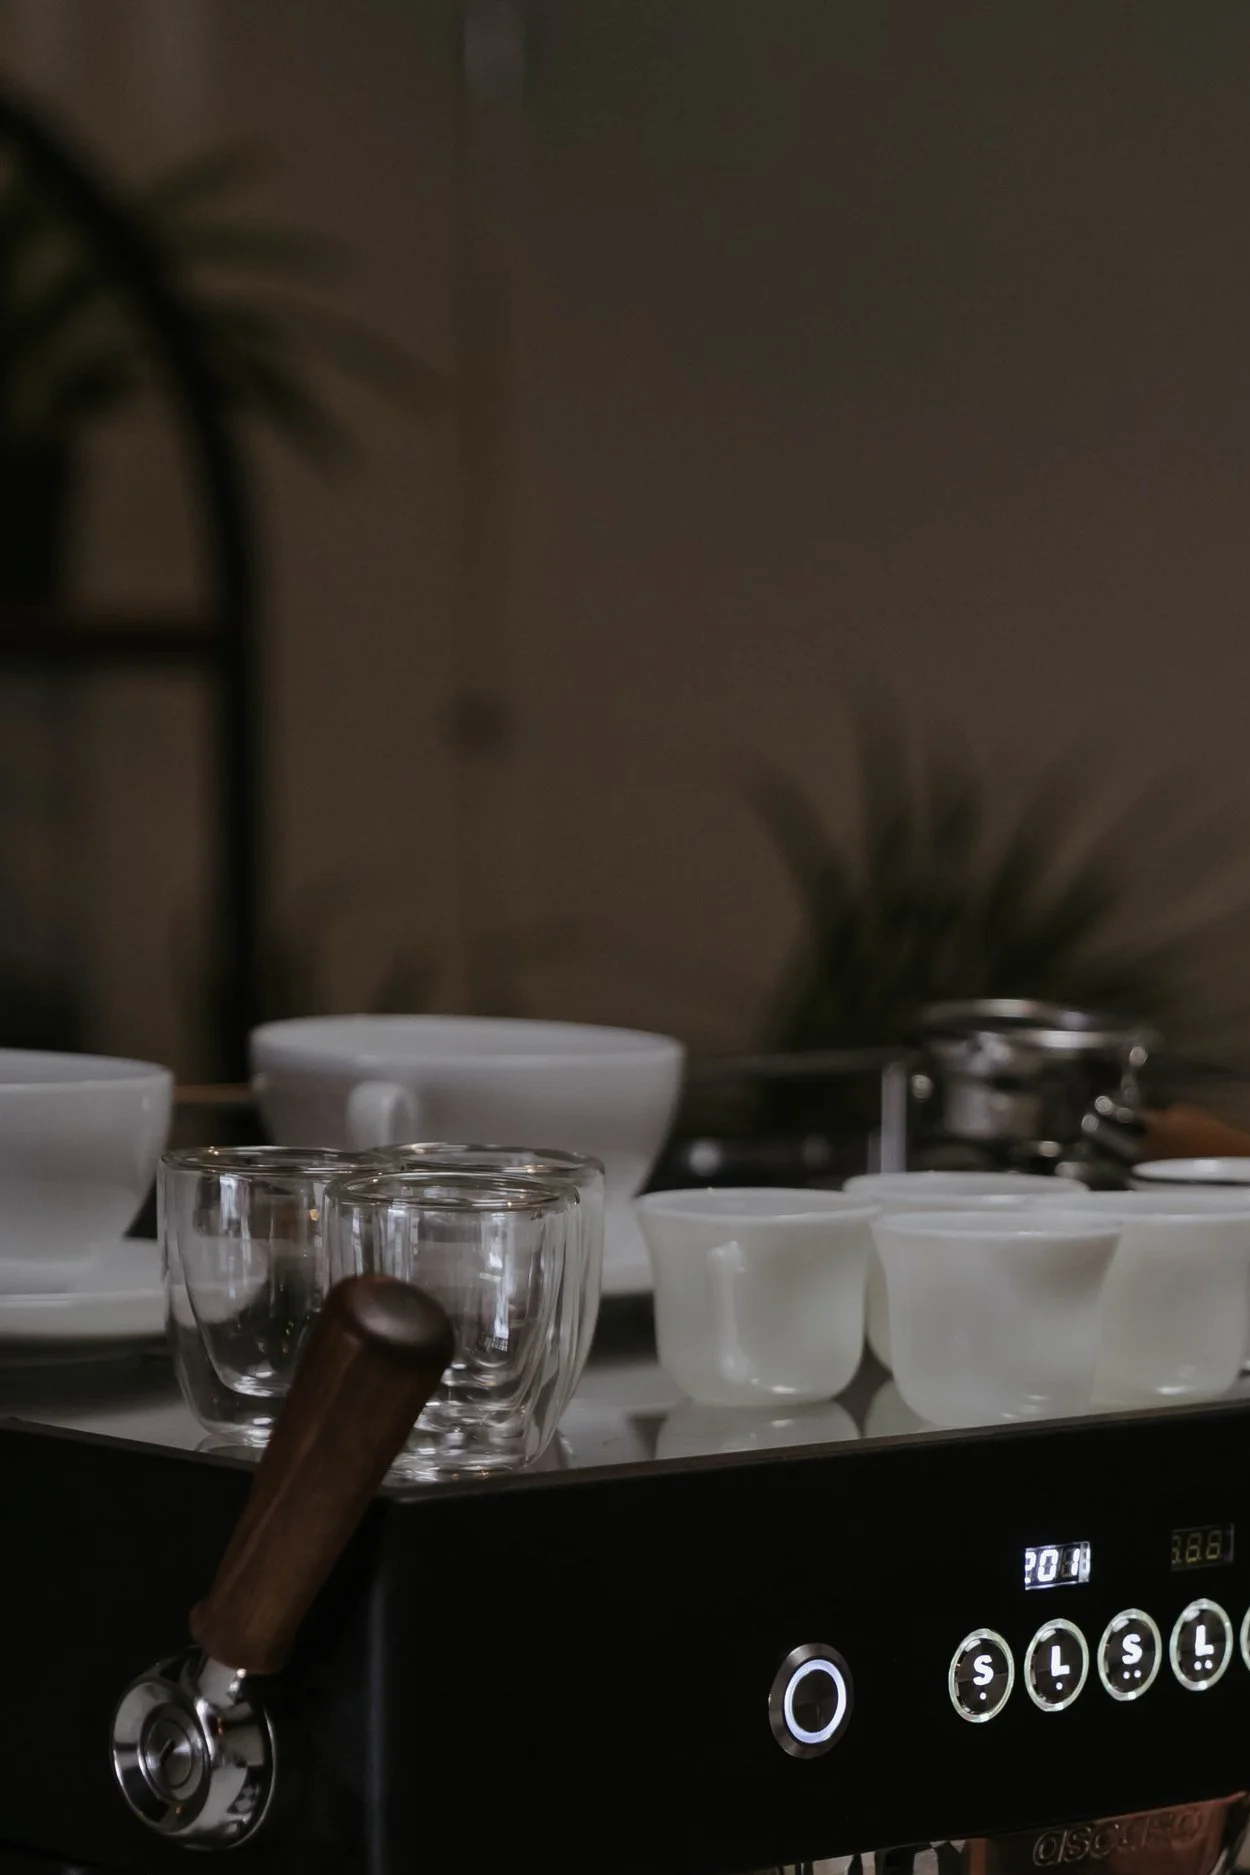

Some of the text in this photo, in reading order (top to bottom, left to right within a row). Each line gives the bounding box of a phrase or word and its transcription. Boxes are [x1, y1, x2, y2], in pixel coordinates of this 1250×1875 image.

[972, 1654, 995, 1686] S
[1050, 1645, 1071, 1677] L
[1121, 1633, 1143, 1665] S
[1194, 1624, 1215, 1656] L
